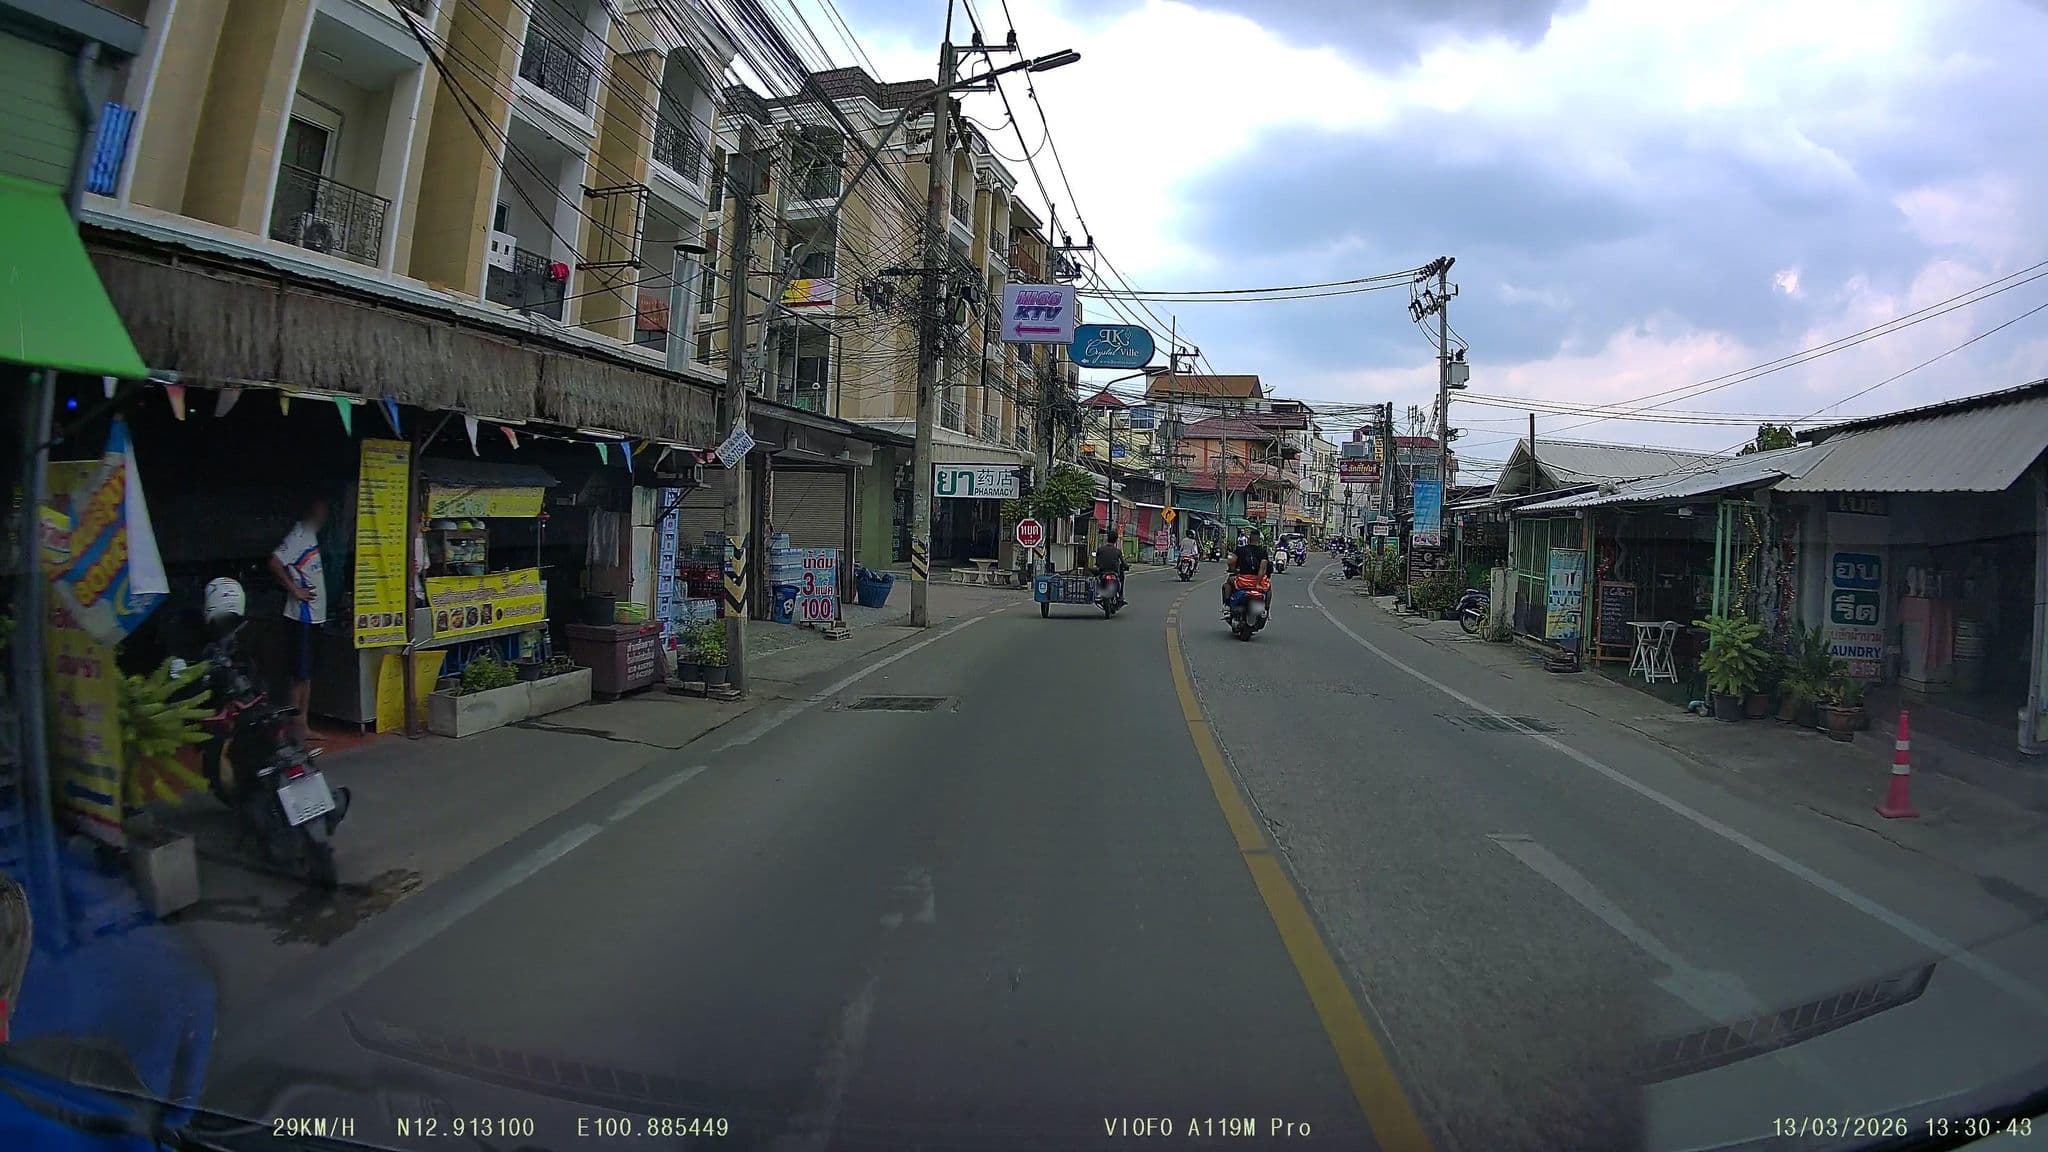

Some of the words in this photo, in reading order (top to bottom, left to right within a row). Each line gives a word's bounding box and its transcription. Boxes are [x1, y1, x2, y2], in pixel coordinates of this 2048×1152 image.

[1013, 305, 1063, 321] KTV
[1085, 338, 1122, 364] Crystal
[1120, 347, 1139, 357] Ville
[937, 470, 975, 497] ยา
[977, 468, 1013, 487] 药店
[974, 487, 1014, 497] PHARMACY
[1020, 525, 1039, 539] หยุด
[803, 550, 833, 569] น้ำดื่ม
[1835, 561, 1879, 581] อบ
[802, 571, 815, 596] 3
[1835, 593, 1877, 622] รีด
[1830, 645, 1881, 658] AUNDRY
